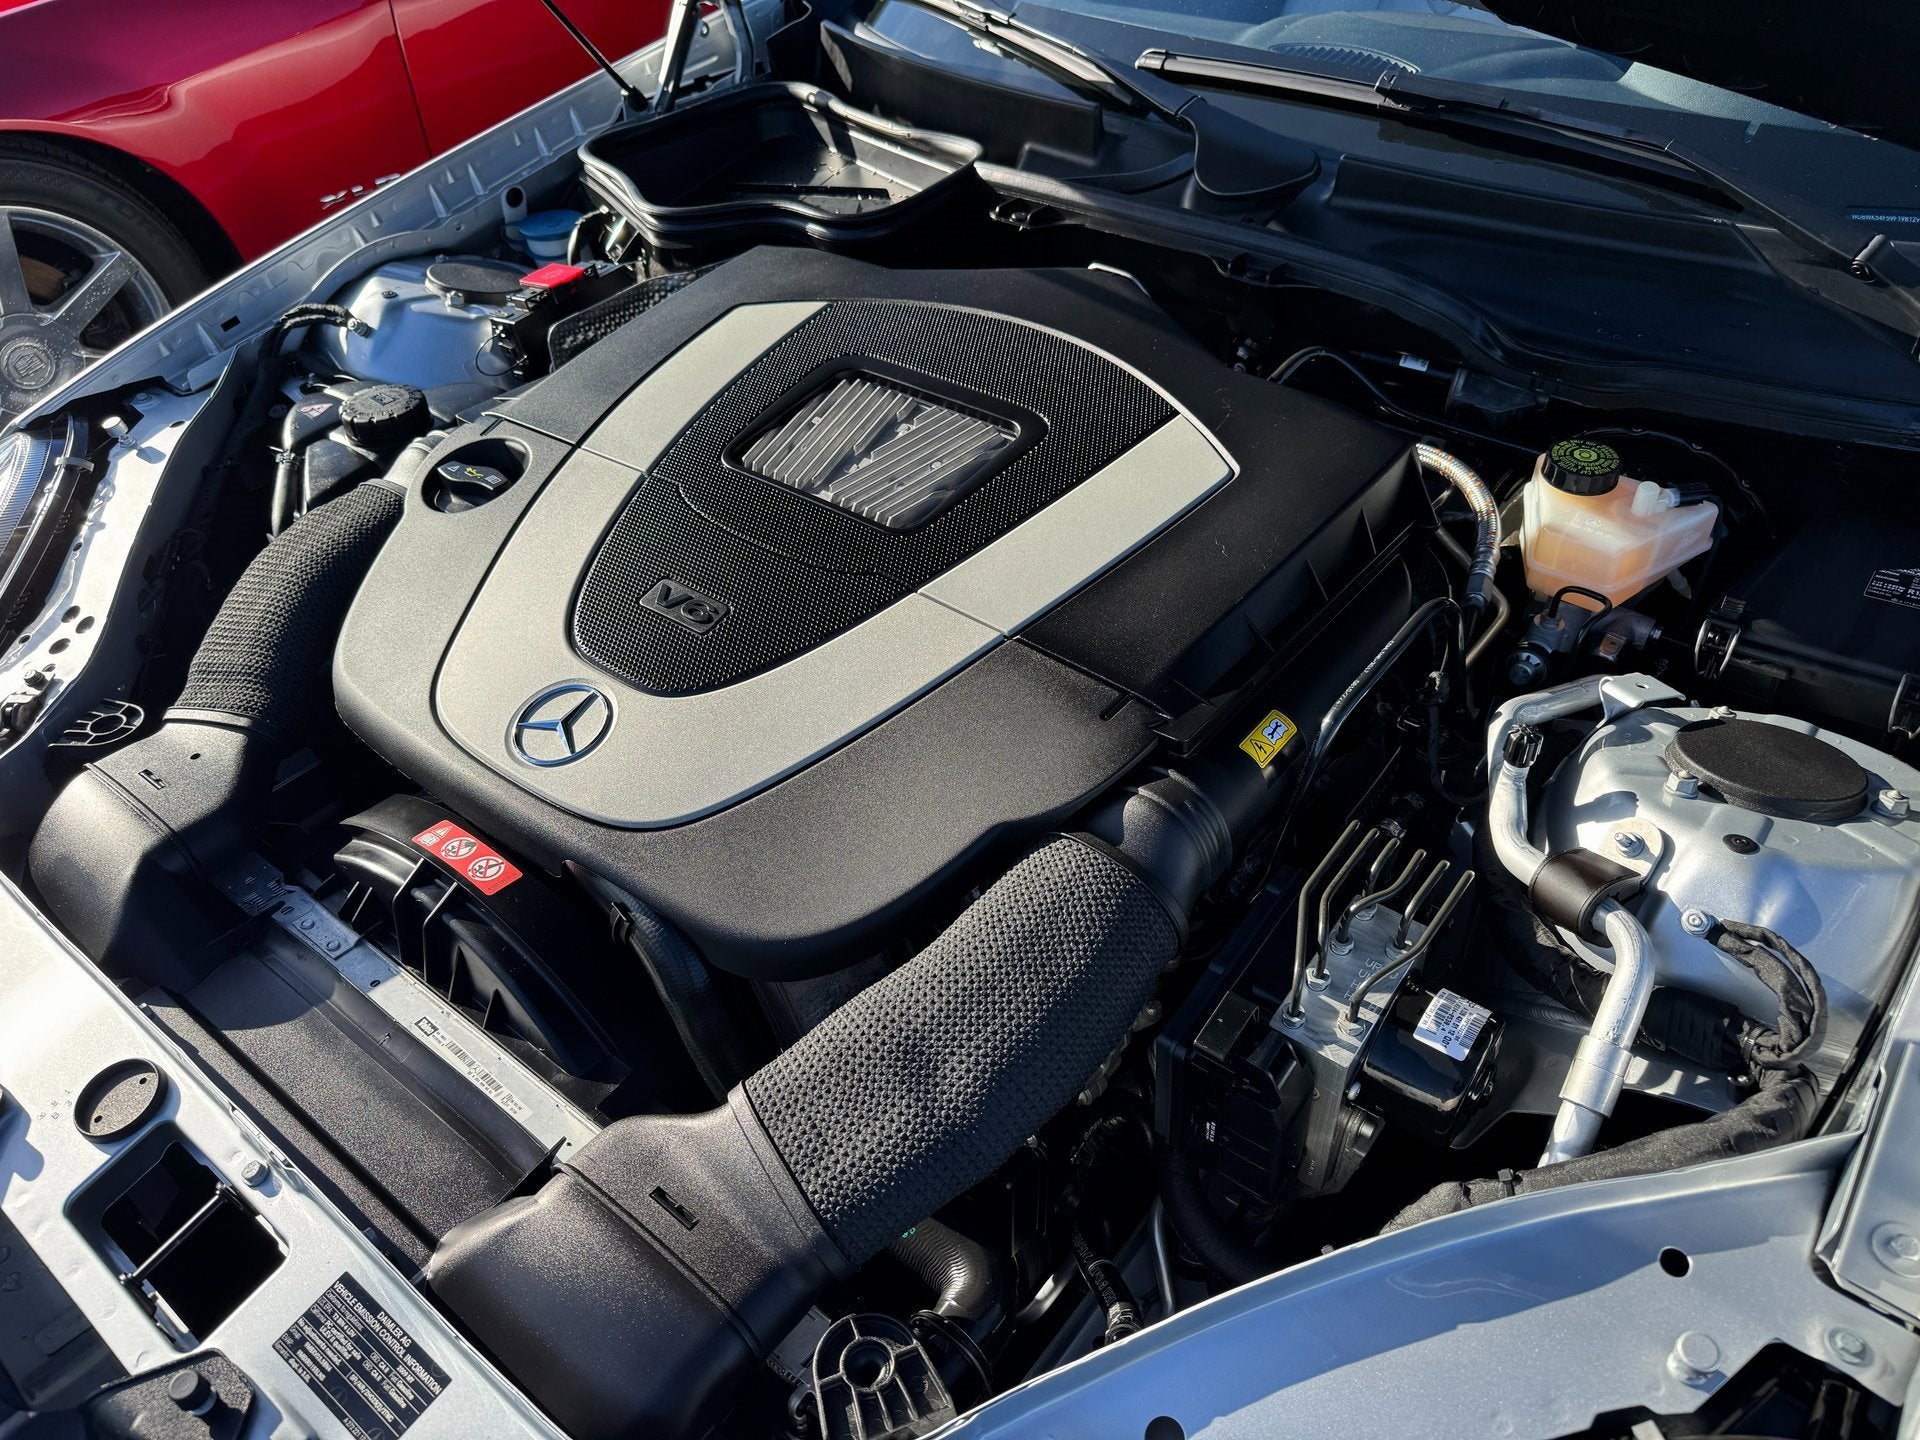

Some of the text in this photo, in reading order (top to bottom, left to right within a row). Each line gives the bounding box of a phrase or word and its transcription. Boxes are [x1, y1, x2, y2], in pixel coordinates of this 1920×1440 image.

[656, 583, 720, 624] V6
[324, 1289, 343, 1308] Conforms
[301, 1323, 328, 1351] adjustments
[318, 1325, 332, 1339] ULEV
[331, 1339, 352, 1360] qualified
[332, 1280, 442, 1395] VEHICLE EMISSION CONTROL INFORMATION
[376, 1310, 412, 1348] DAIMLER AG
[324, 1319, 333, 1329] PC
[329, 1325, 348, 1345] certified
[344, 1341, 354, 1351] for
[350, 1348, 362, 1360] sale
[387, 1387, 408, 1409] Gasoline
[394, 1379, 415, 1400] Gasoline
